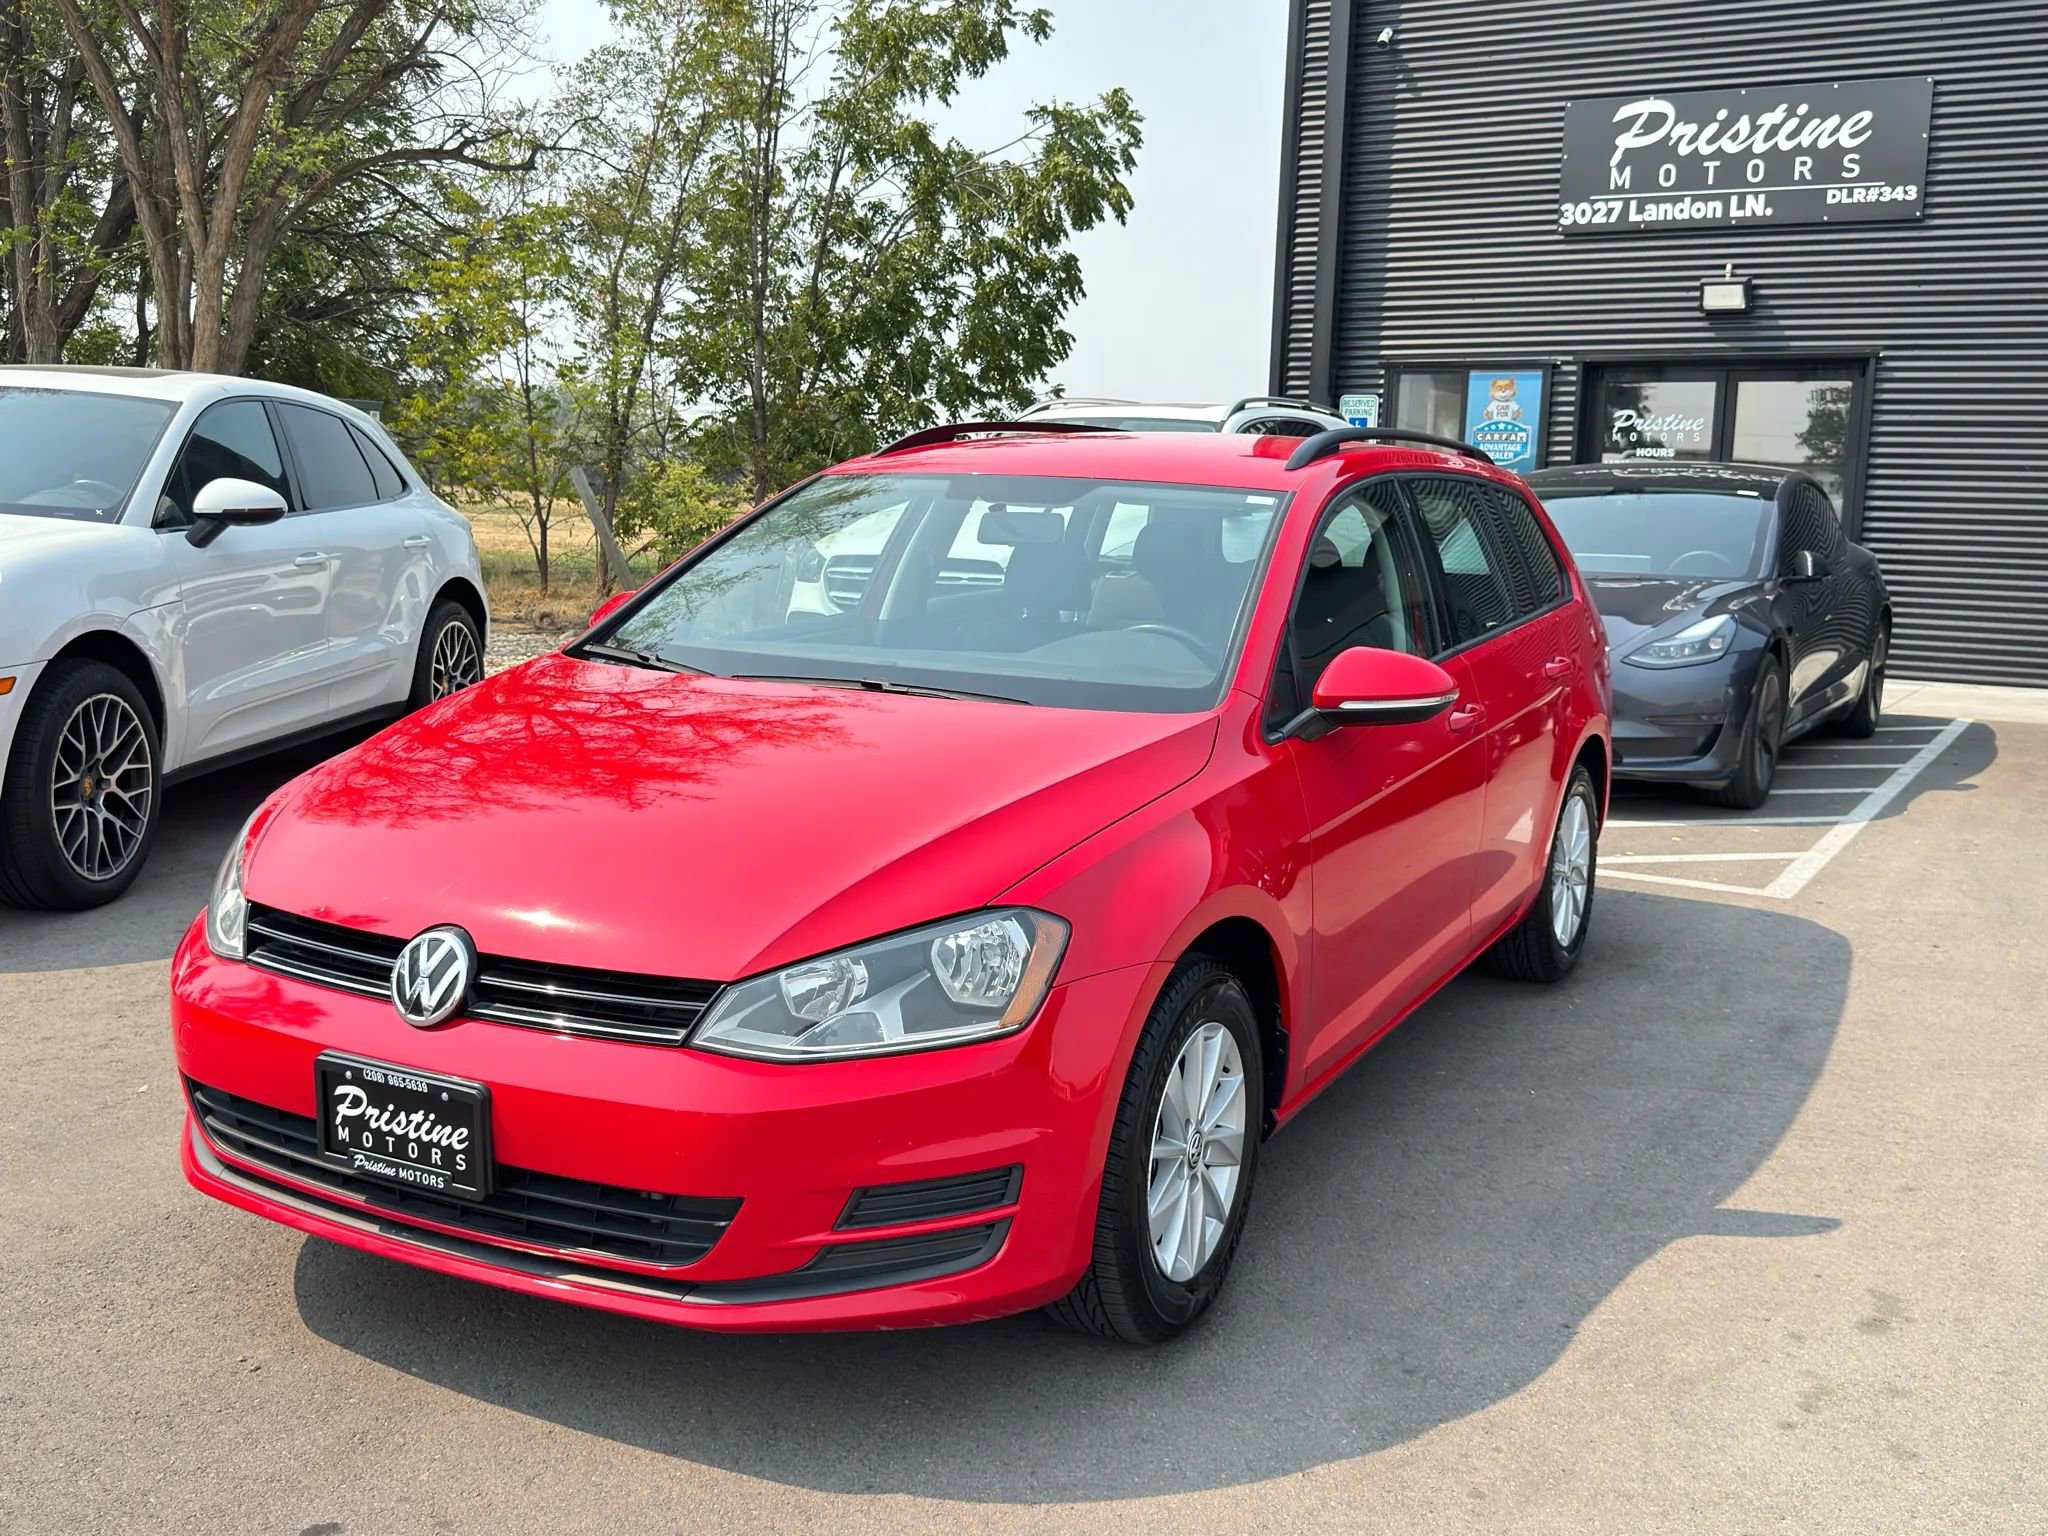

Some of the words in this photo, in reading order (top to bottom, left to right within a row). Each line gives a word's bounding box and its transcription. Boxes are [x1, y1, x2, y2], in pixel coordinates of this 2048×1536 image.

[1610, 99, 1874, 167] Pristine
[1609, 154, 1861, 190] MOTORS
[1826, 184, 1918, 206] DLR#343
[1559, 200, 1623, 226] 3027
[1629, 197, 1722, 223] Landon
[1729, 193, 1773, 218] LN.
[1343, 399, 1375, 408] RESERVED
[1344, 408, 1373, 417] PARKING
[1612, 409, 1705, 433] Pristine
[1476, 432, 1526, 442] CARFAX
[1479, 443, 1521, 451] ADVANTAGE
[1612, 432, 1700, 442] MOTORS
[1636, 447, 1675, 458] HOURS
[363, 1068, 385, 1083] (208)
[334, 1085, 469, 1150] Pristine
[338, 1125, 467, 1171] MOTORS
[353, 1154, 396, 1177] Pristine
[399, 1167, 445, 1188] MOTORS
